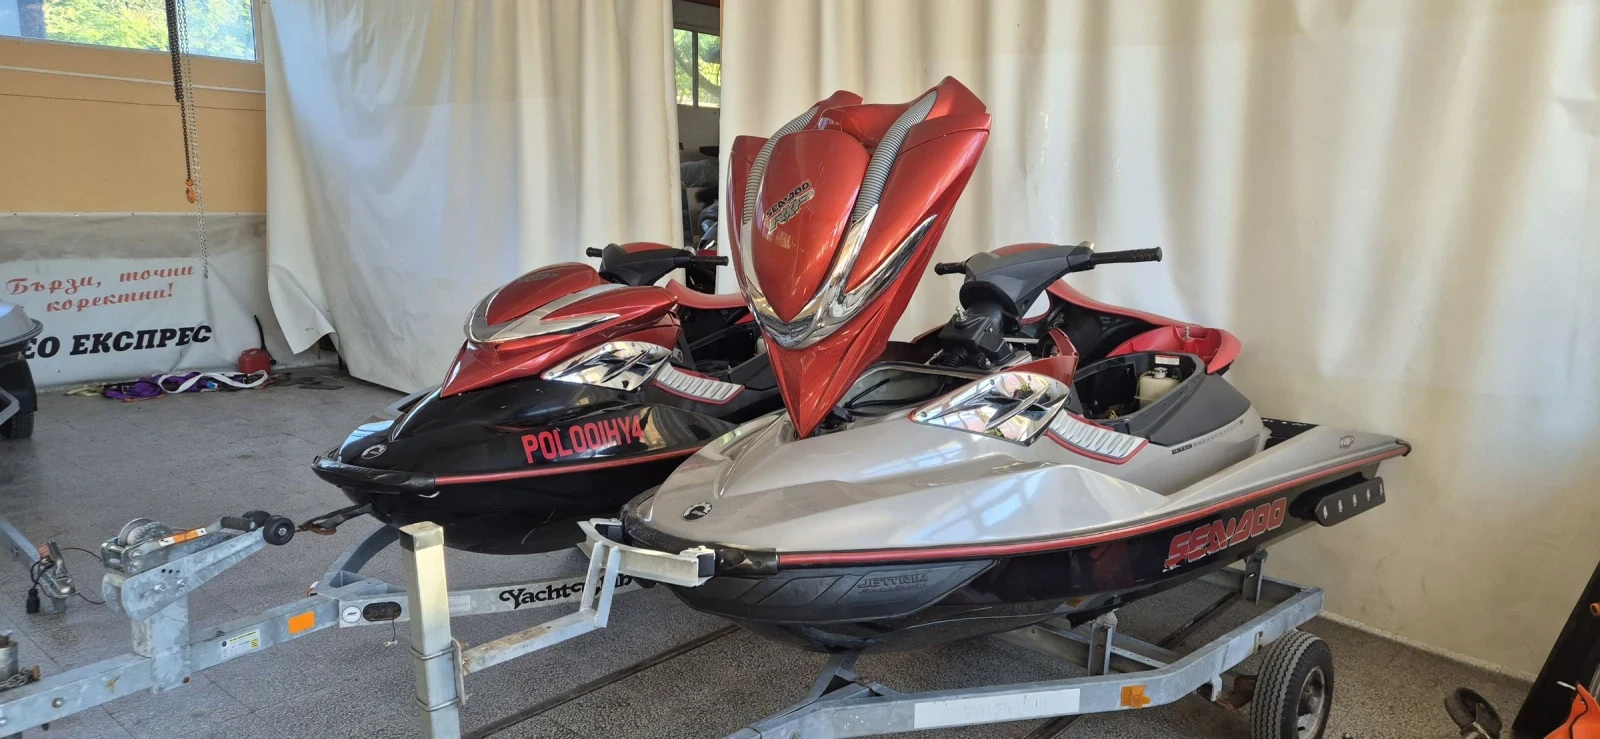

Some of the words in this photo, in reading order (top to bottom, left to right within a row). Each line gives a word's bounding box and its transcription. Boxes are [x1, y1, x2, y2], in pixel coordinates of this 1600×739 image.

[6, 276, 102, 296] Бързи,
[119, 265, 194, 283] точни
[46, 282, 174, 312] коректни!
[70, 325, 212, 355] ЕКСПРЕС
